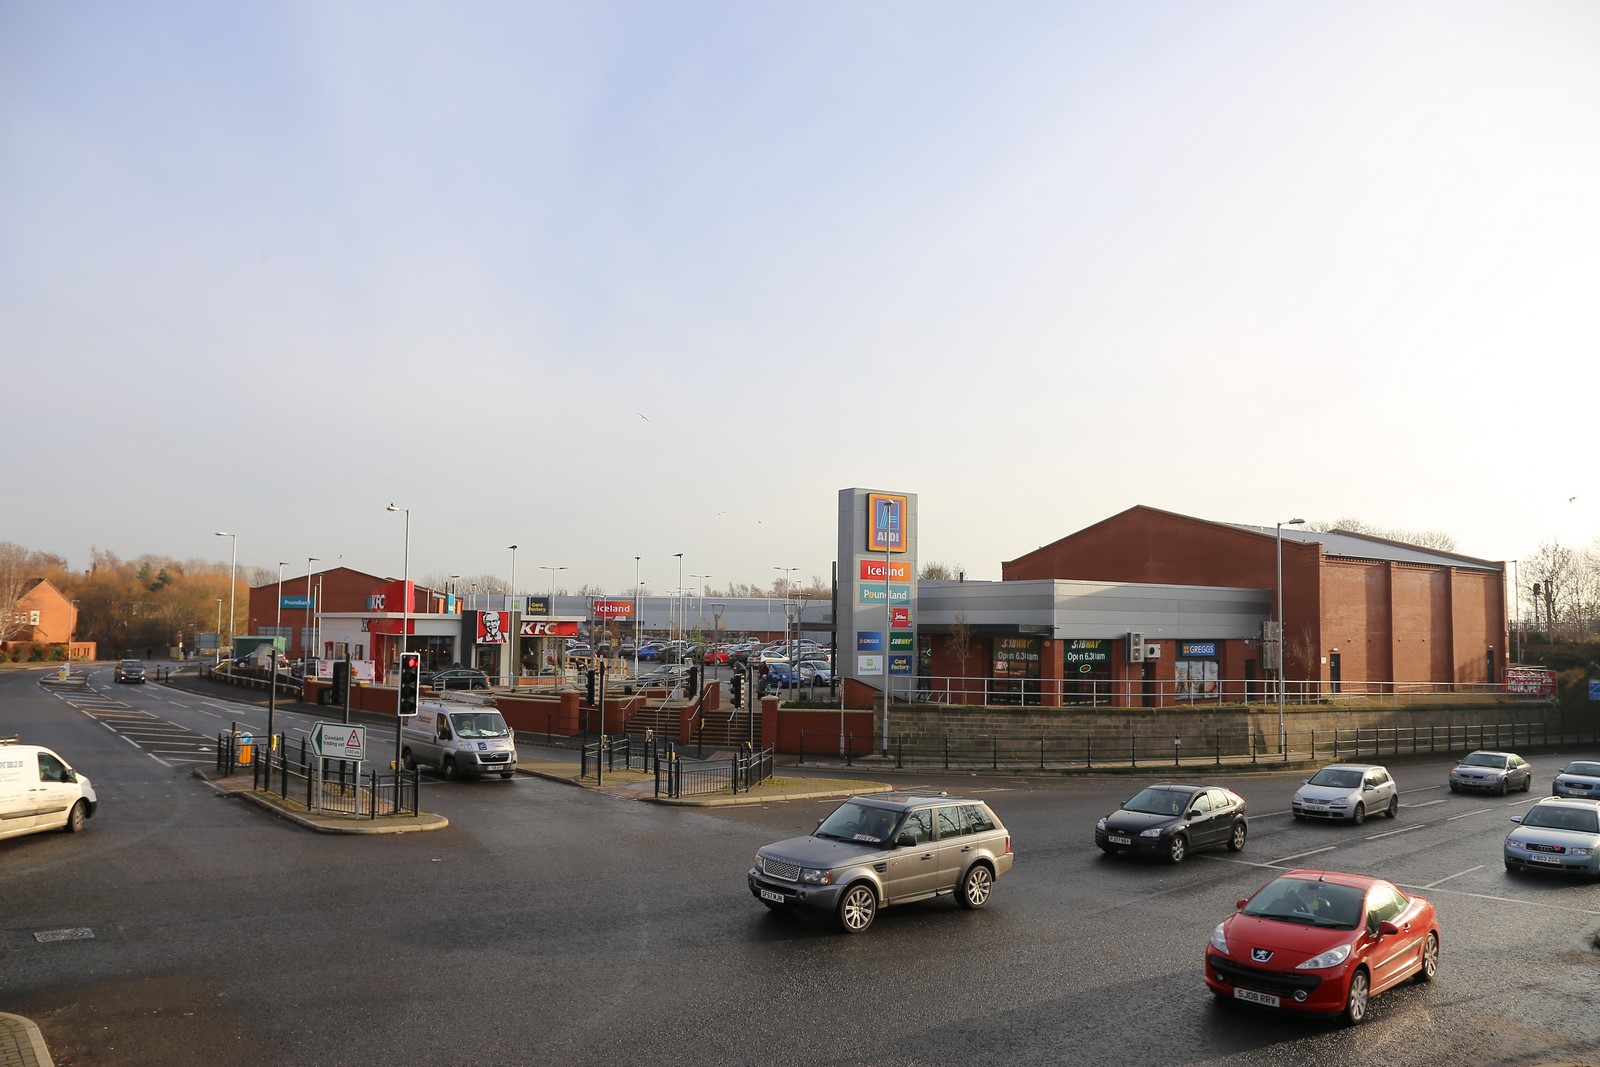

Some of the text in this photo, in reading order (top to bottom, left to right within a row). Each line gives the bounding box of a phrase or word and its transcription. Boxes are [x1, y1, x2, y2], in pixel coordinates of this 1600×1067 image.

[877, 531, 900, 542] ALDI
[370, 594, 385, 609] KFC
[596, 604, 631, 613] Iceland
[520, 622, 557, 635] KFC
[1189, 645, 1214, 654] GREGGS
[1238, 990, 1276, 1005] SJ08 RRV
